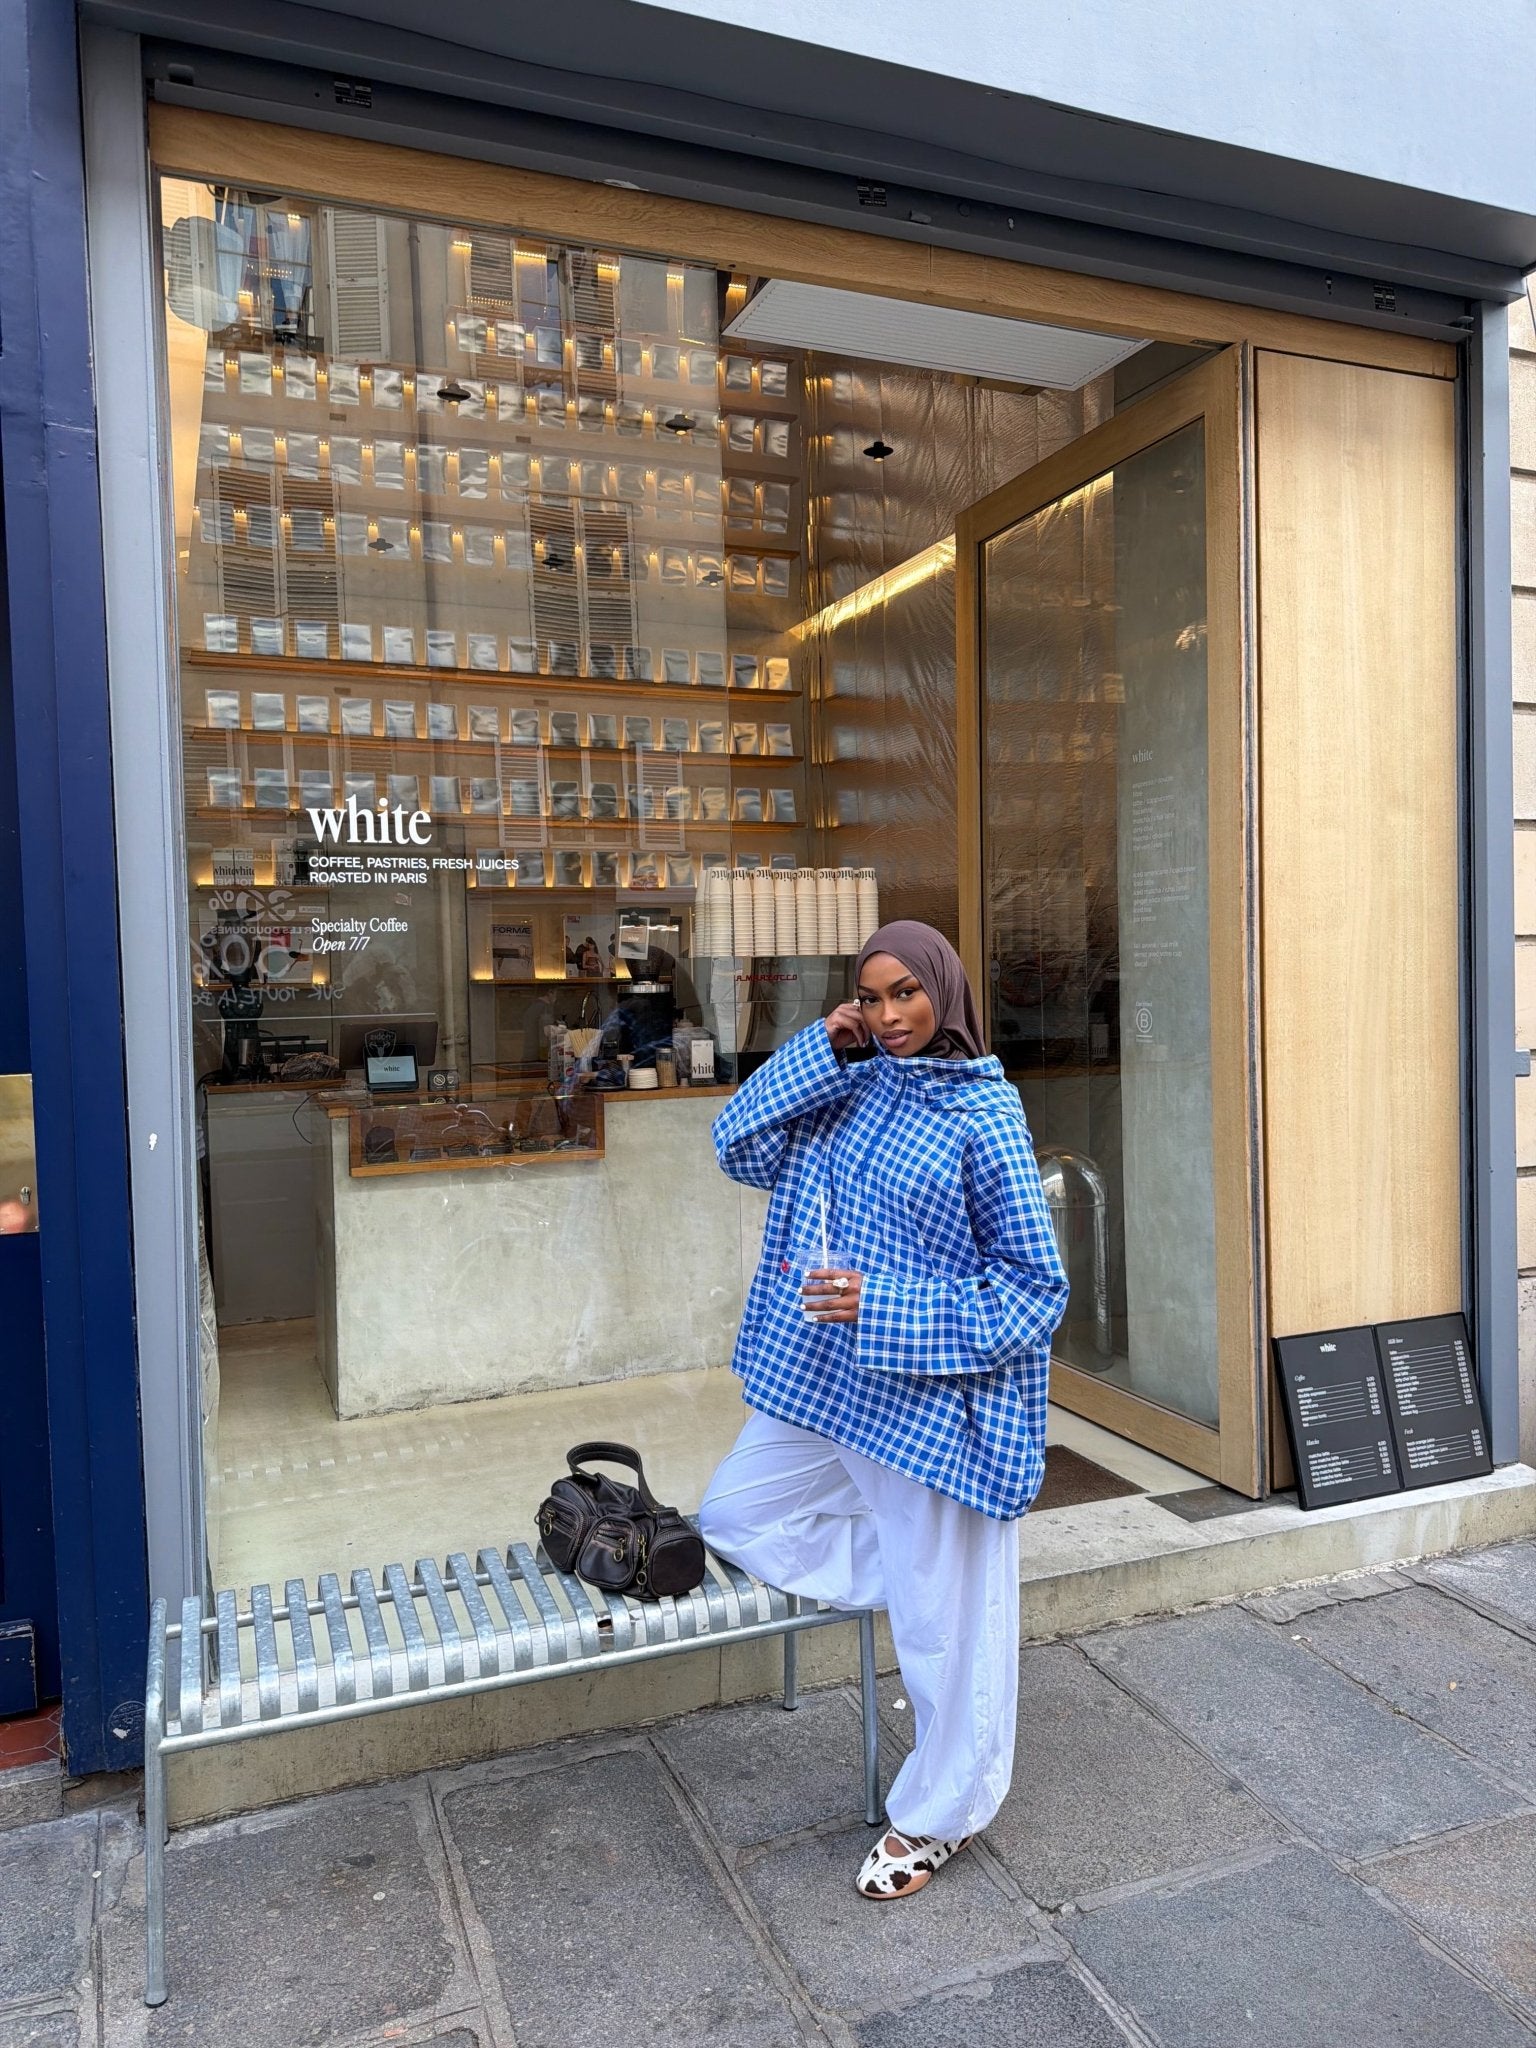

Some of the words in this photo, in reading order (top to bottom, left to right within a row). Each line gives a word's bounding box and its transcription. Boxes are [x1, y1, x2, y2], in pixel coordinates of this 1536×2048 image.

[306, 794, 432, 845] white
[308, 856, 364, 870] COFFEE,
[367, 857, 430, 871] PASTRIES,
[432, 858, 473, 870] FRESH
[475, 858, 520, 871] JUICES
[309, 871, 372, 885] ROASTED
[374, 872, 388, 884] IN
[390, 872, 428, 884] PARIS
[311, 917, 367, 936] Specialty
[369, 917, 409, 933] Coffee
[312, 936, 346, 955] Open
[348, 936, 371, 951] 7/7
